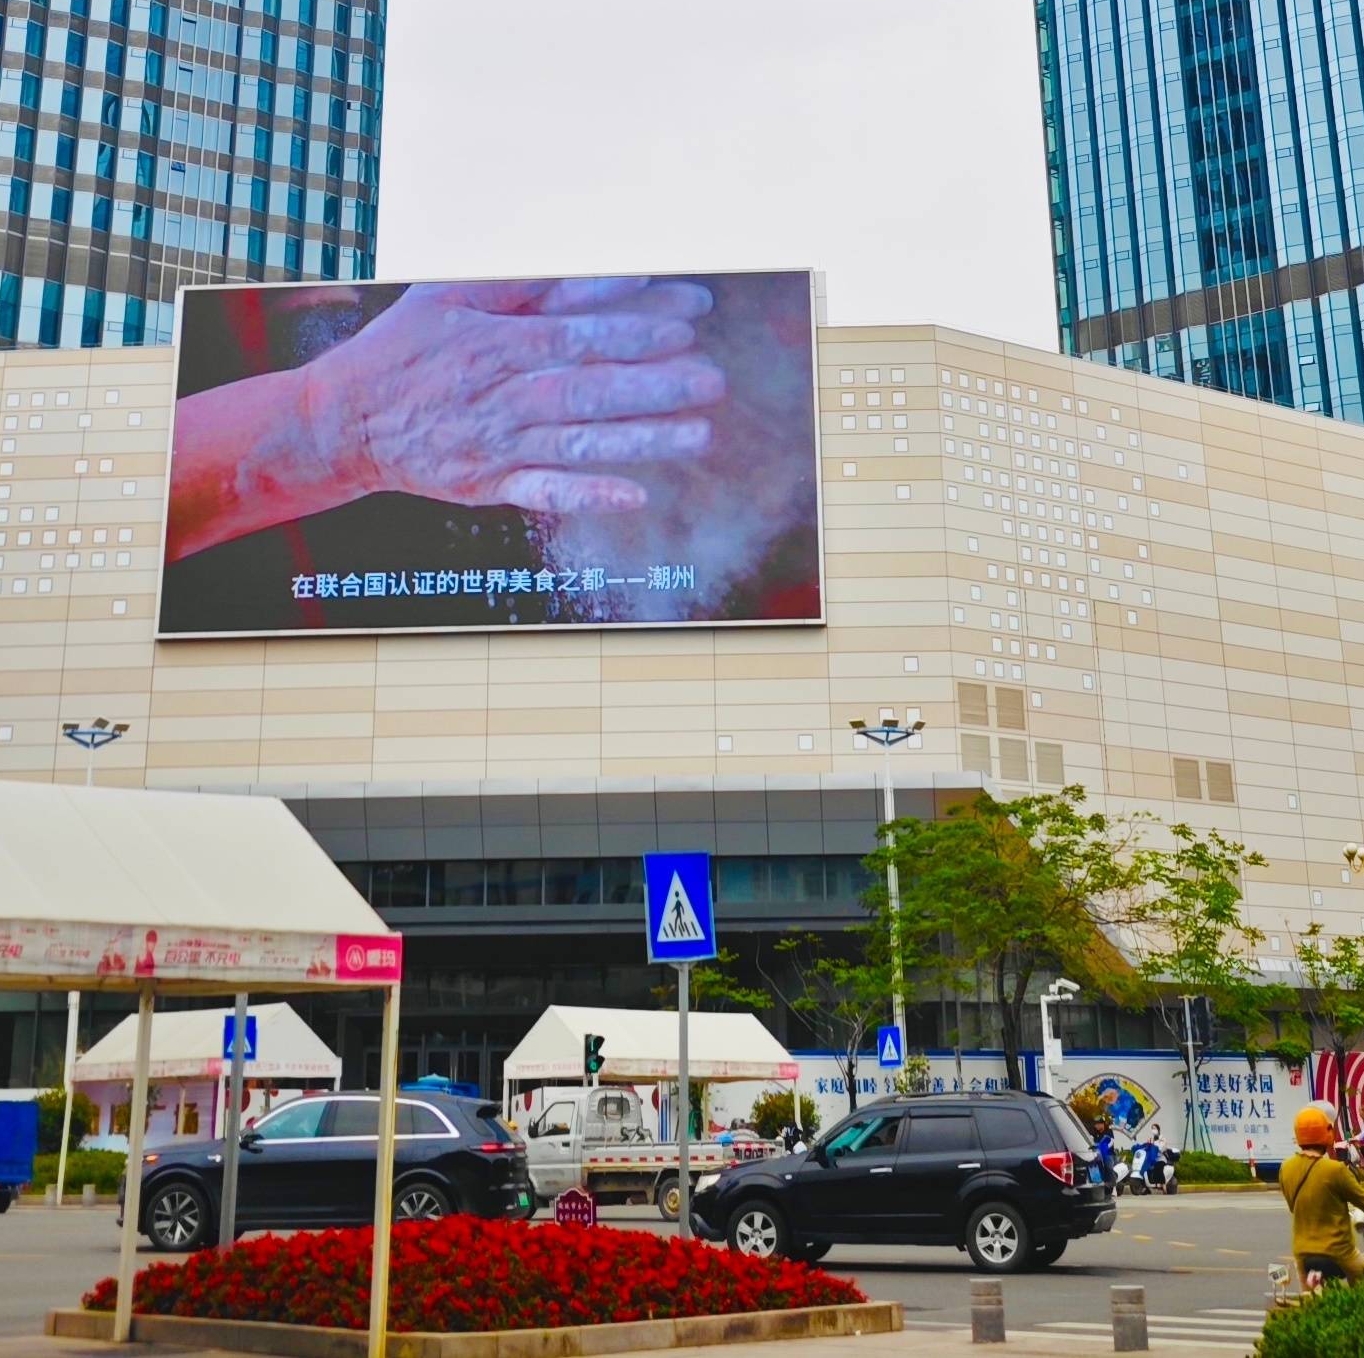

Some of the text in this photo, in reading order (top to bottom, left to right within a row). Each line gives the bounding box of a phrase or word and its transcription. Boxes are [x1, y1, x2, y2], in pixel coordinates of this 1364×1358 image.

[290, 564, 696, 600] 在联合国认证的世界美食之都——潮州
[164, 950, 242, 965] 百公里 不充电
